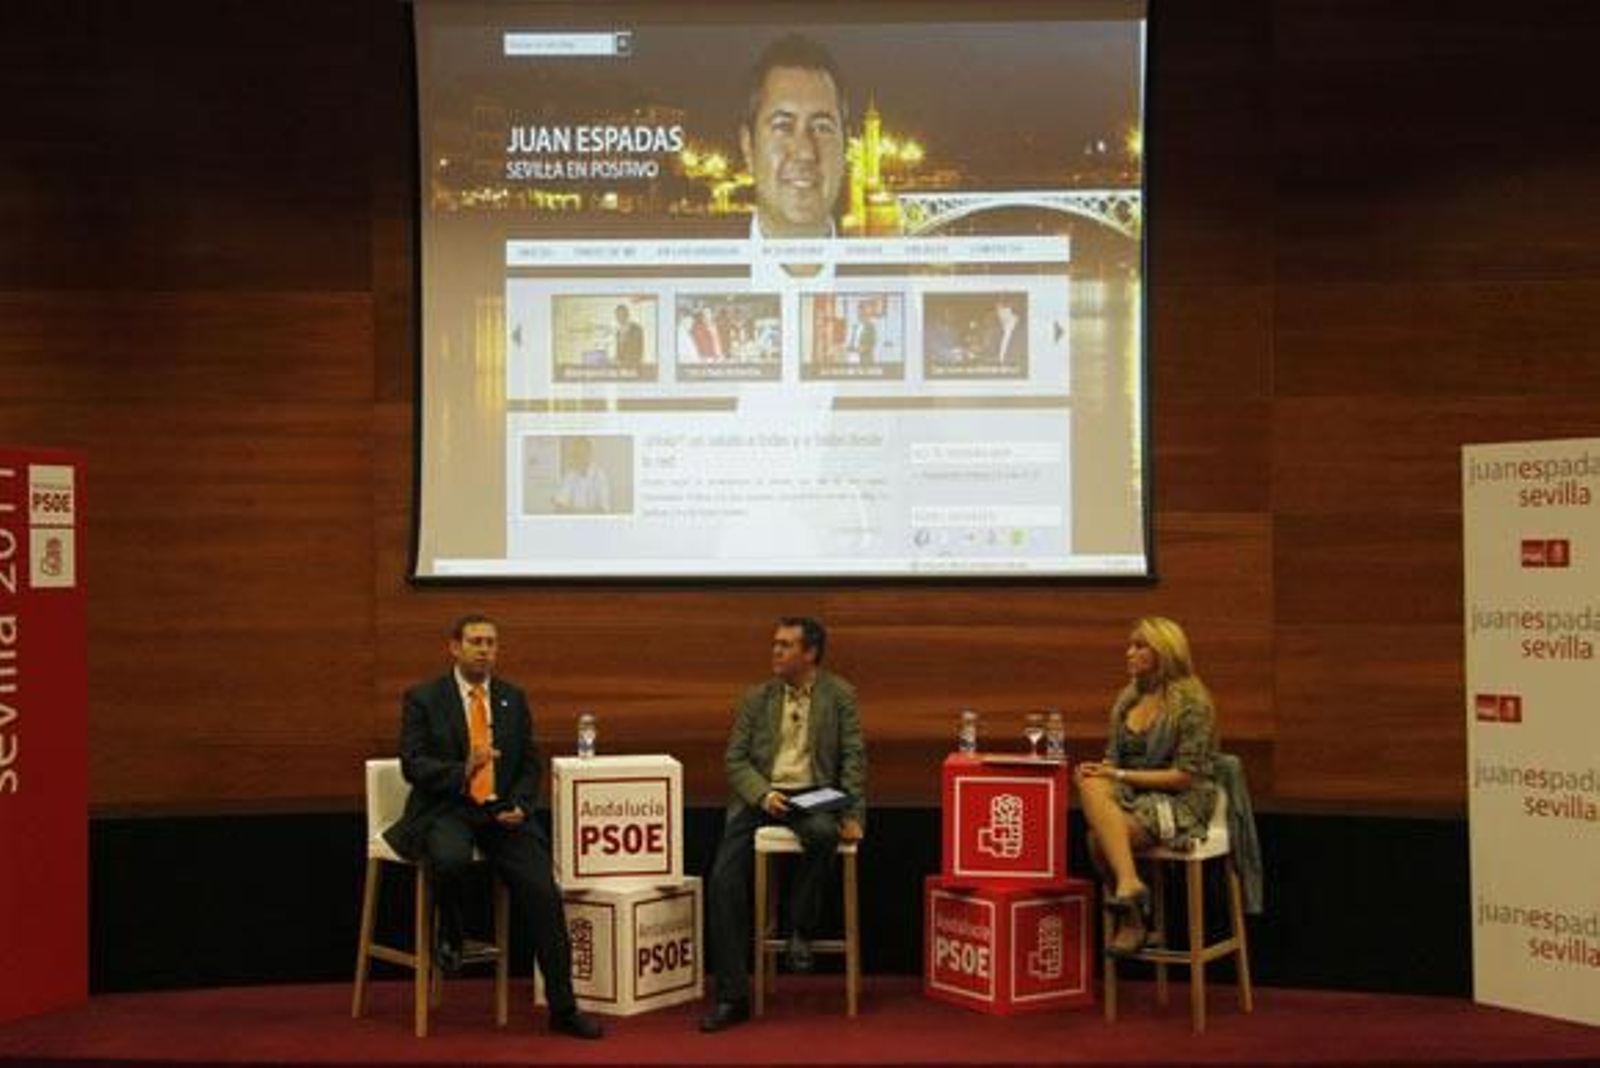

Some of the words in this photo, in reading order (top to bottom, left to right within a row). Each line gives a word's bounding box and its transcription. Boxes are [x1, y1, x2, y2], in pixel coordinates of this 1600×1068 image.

[507, 126, 571, 152] JUAN
[576, 125, 684, 152] ESPADAS
[506, 161, 565, 179] SEVILLA
[567, 161, 587, 179] EN
[590, 161, 659, 179] POSITIVO
[1519, 480, 1592, 507] sevilla
[1521, 635, 1594, 660] sevilla
[1523, 793, 1598, 822] sevilla
[581, 824, 665, 855] PSOE
[1478, 896, 1600, 937] juanespad
[638, 938, 693, 978] PSOE
[936, 936, 990, 978] PSOE
[1529, 937, 1600, 967] sevilla
